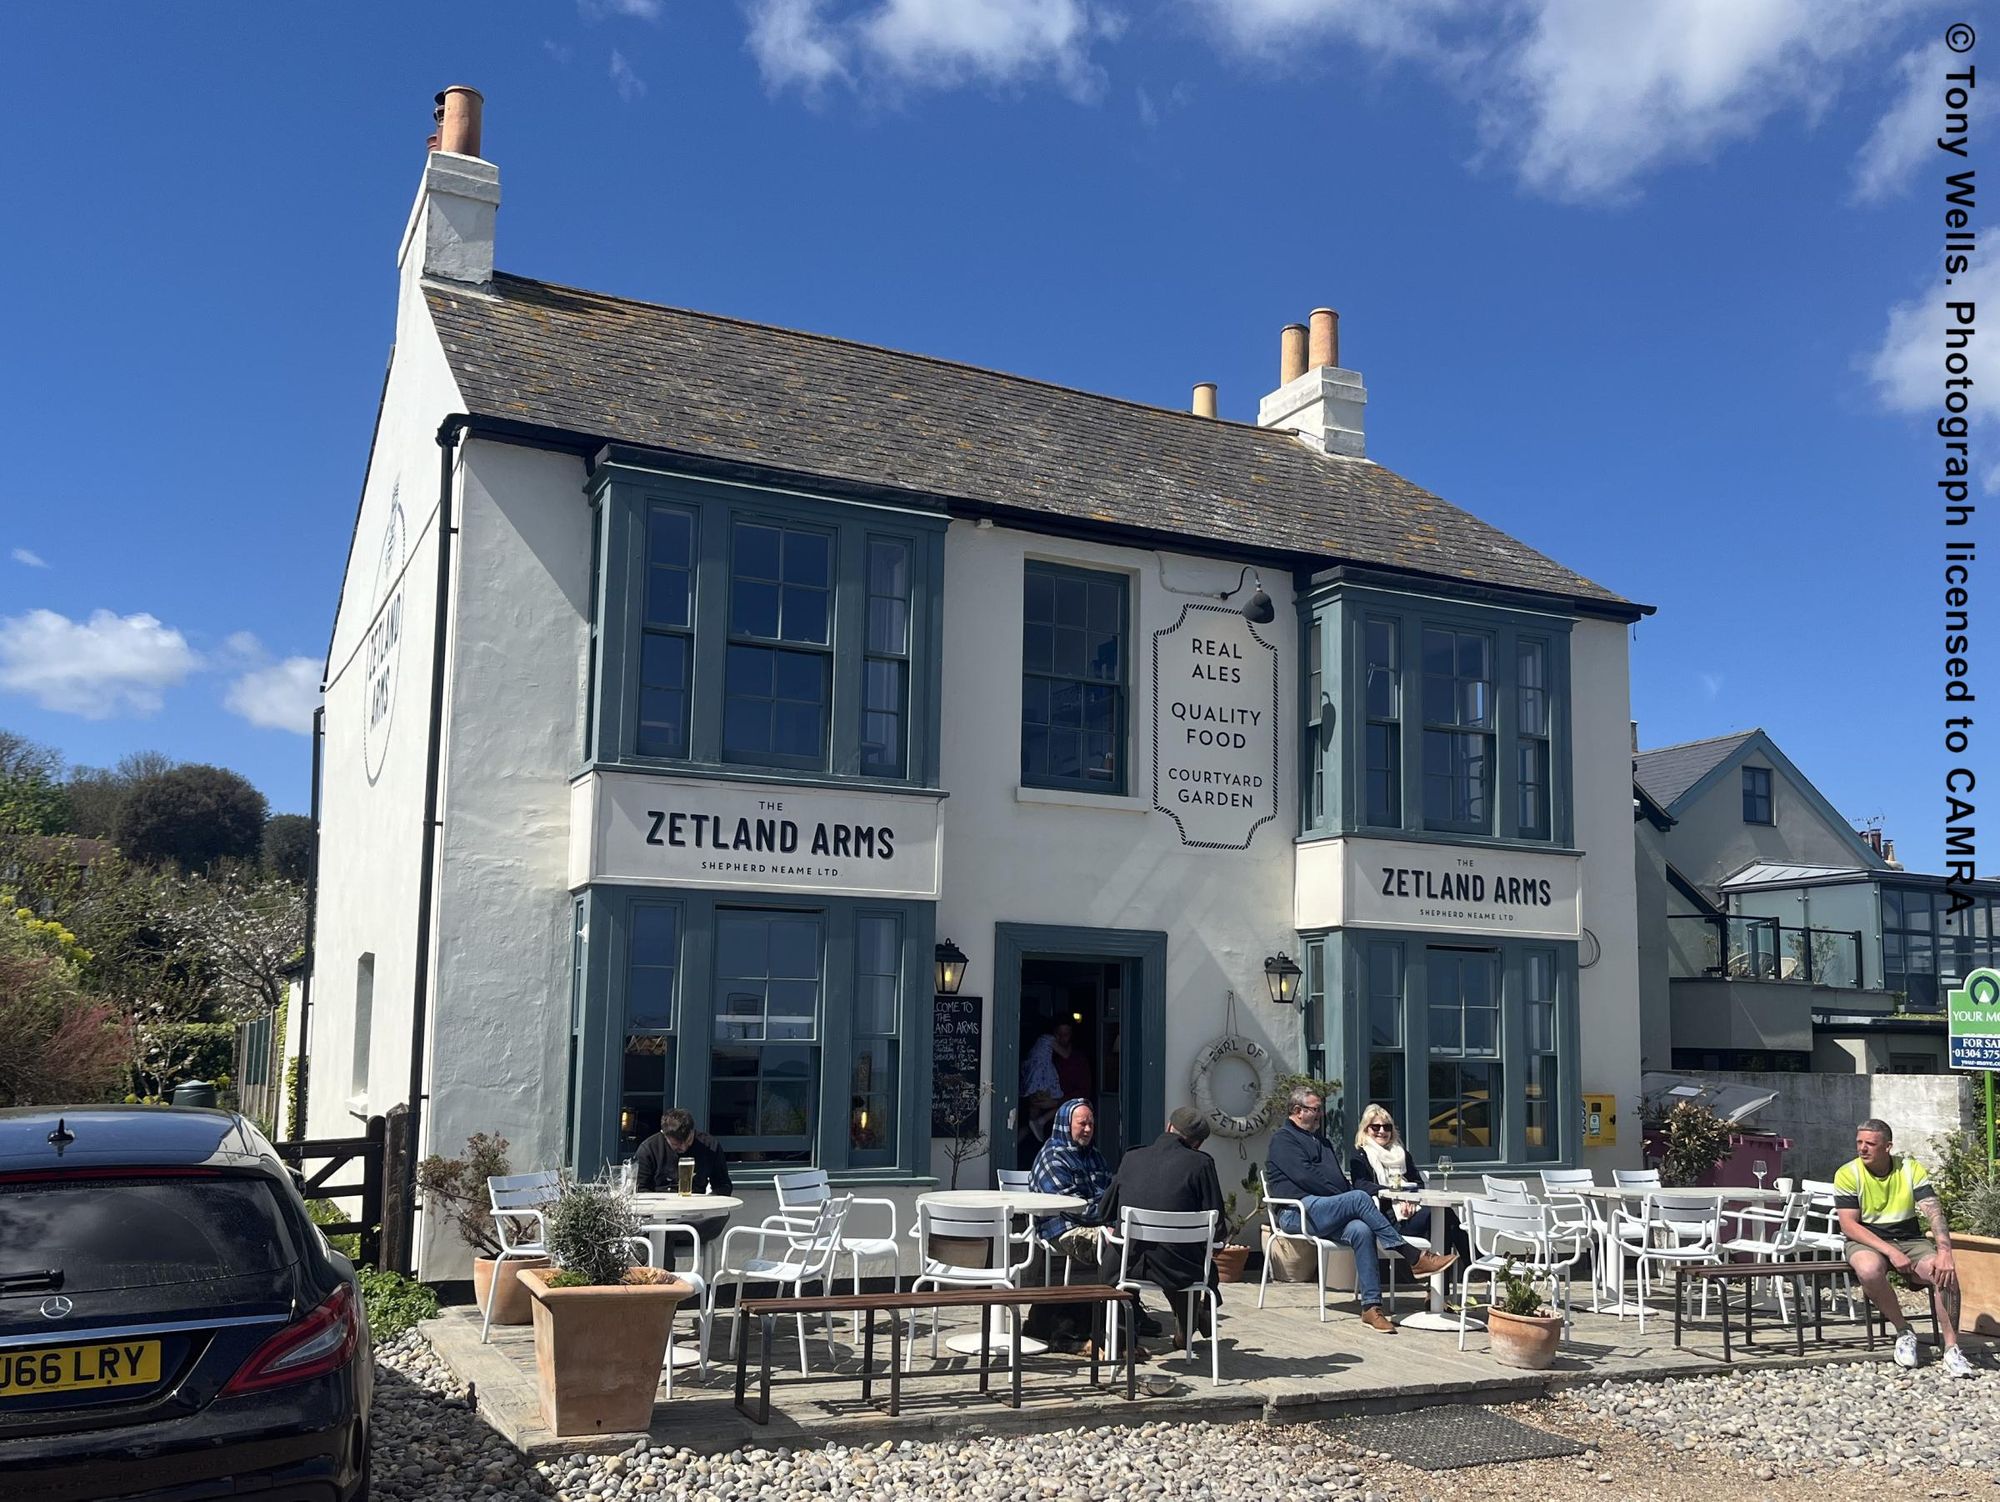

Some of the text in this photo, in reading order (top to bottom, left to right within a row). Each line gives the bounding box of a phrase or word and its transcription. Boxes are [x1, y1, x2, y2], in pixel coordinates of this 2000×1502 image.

[1192, 638, 1243, 659] REAL
[1191, 663, 1241, 683] ALES
[1171, 702, 1261, 726] QUALITY
[1186, 728, 1246, 749] FOOD
[1168, 767, 1263, 788] COURTYARD
[759, 801, 784, 812] THE
[1177, 789, 1253, 808] GARDEN
[646, 810, 895, 860] ZETLAND ARMS
[701, 861, 839, 877] SHEPHERD NEAME LTD
[1457, 858, 1475, 867] THE
[1382, 867, 1552, 907] ZETLAND ARMS
[1419, 909, 1464, 919] SHEPHERD
[1467, 912, 1496, 920] NEAME
[961, 1001, 974, 1013] TO
[1952, 1011, 1983, 1022] YOUR
[933, 1020, 979, 1035] AND ARMS
[935, 1013, 951, 1023] THE
[1209, 1039, 1265, 1063] EARL OF
[1962, 1038, 1983, 1048] FOR
[74, 1346, 144, 1381] LRY
